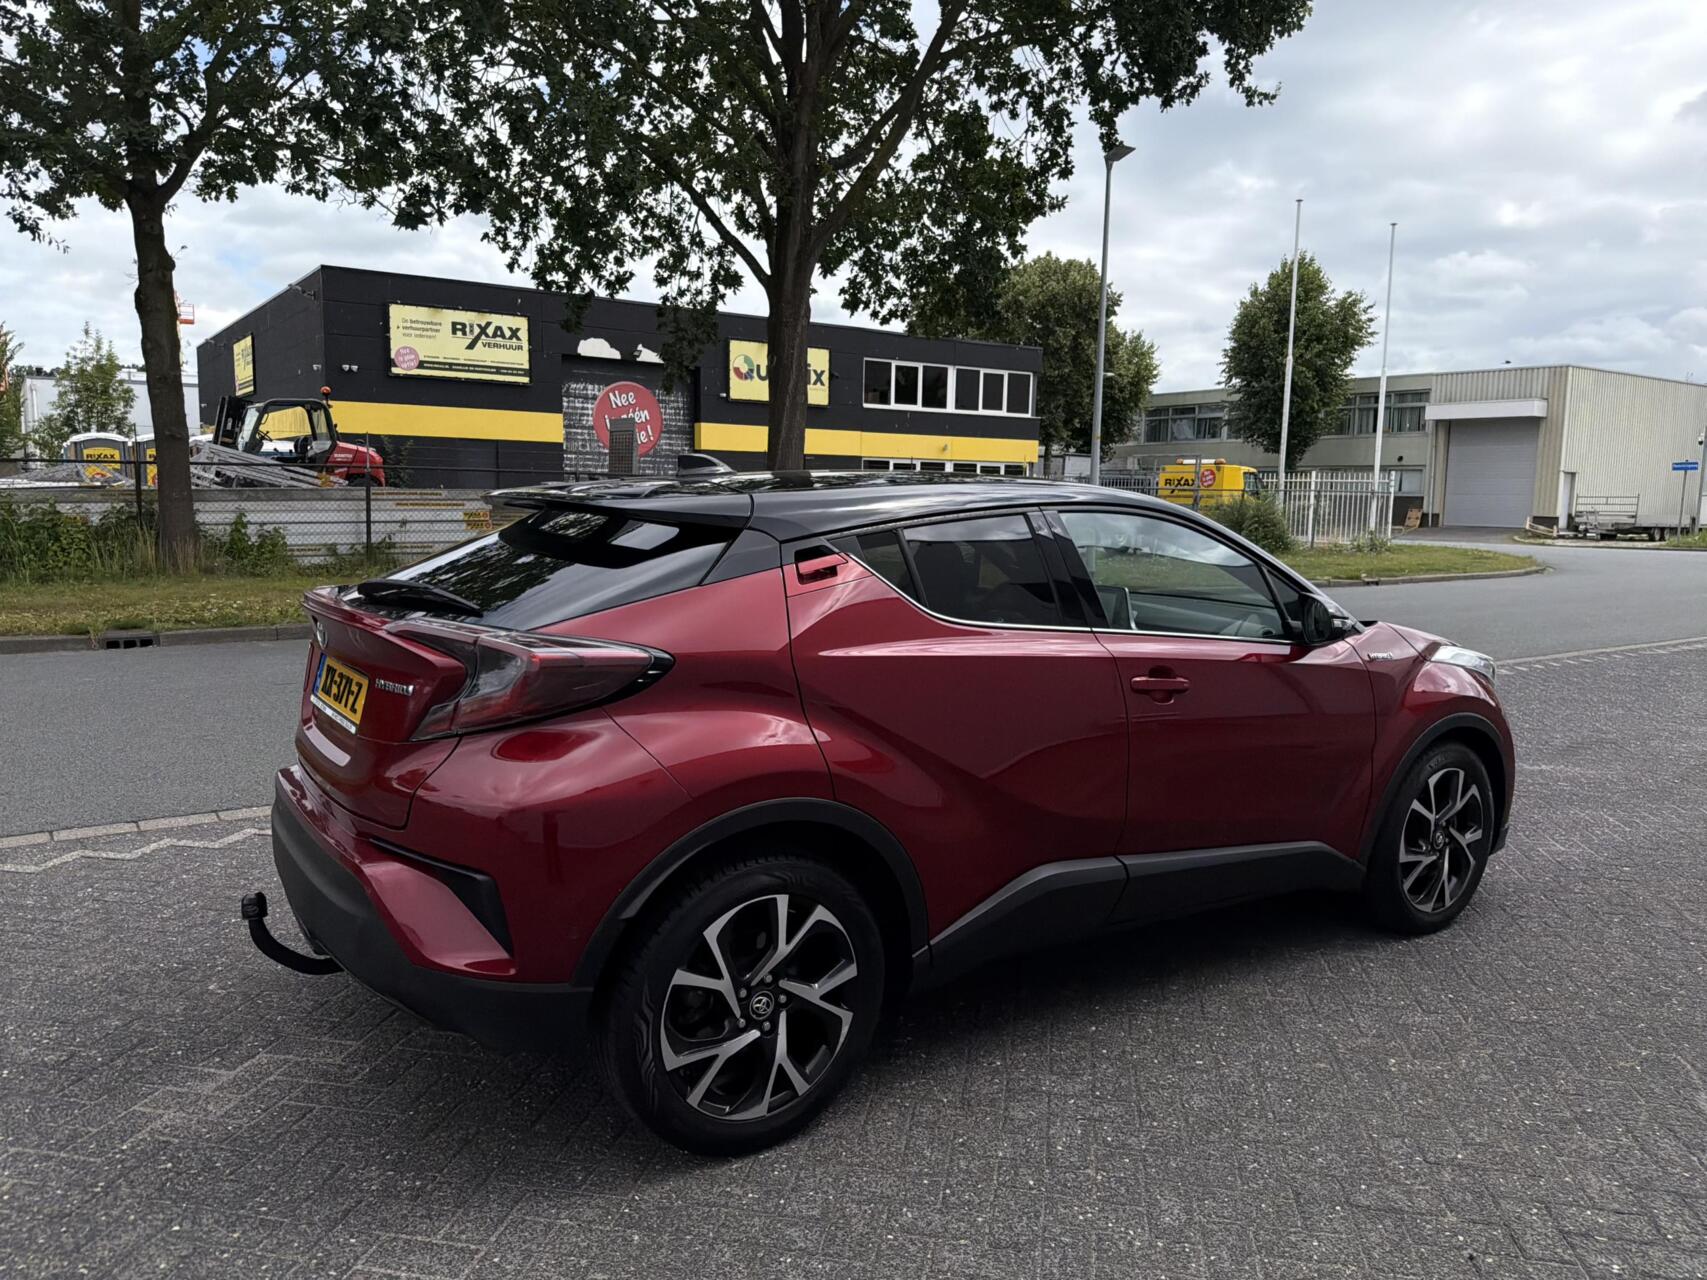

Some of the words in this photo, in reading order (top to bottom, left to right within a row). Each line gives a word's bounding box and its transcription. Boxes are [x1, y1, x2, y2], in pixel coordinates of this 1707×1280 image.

[451, 321, 523, 350] RIXAX
[481, 341, 523, 351] VERHUUR
[608, 390, 636, 409] Nee
